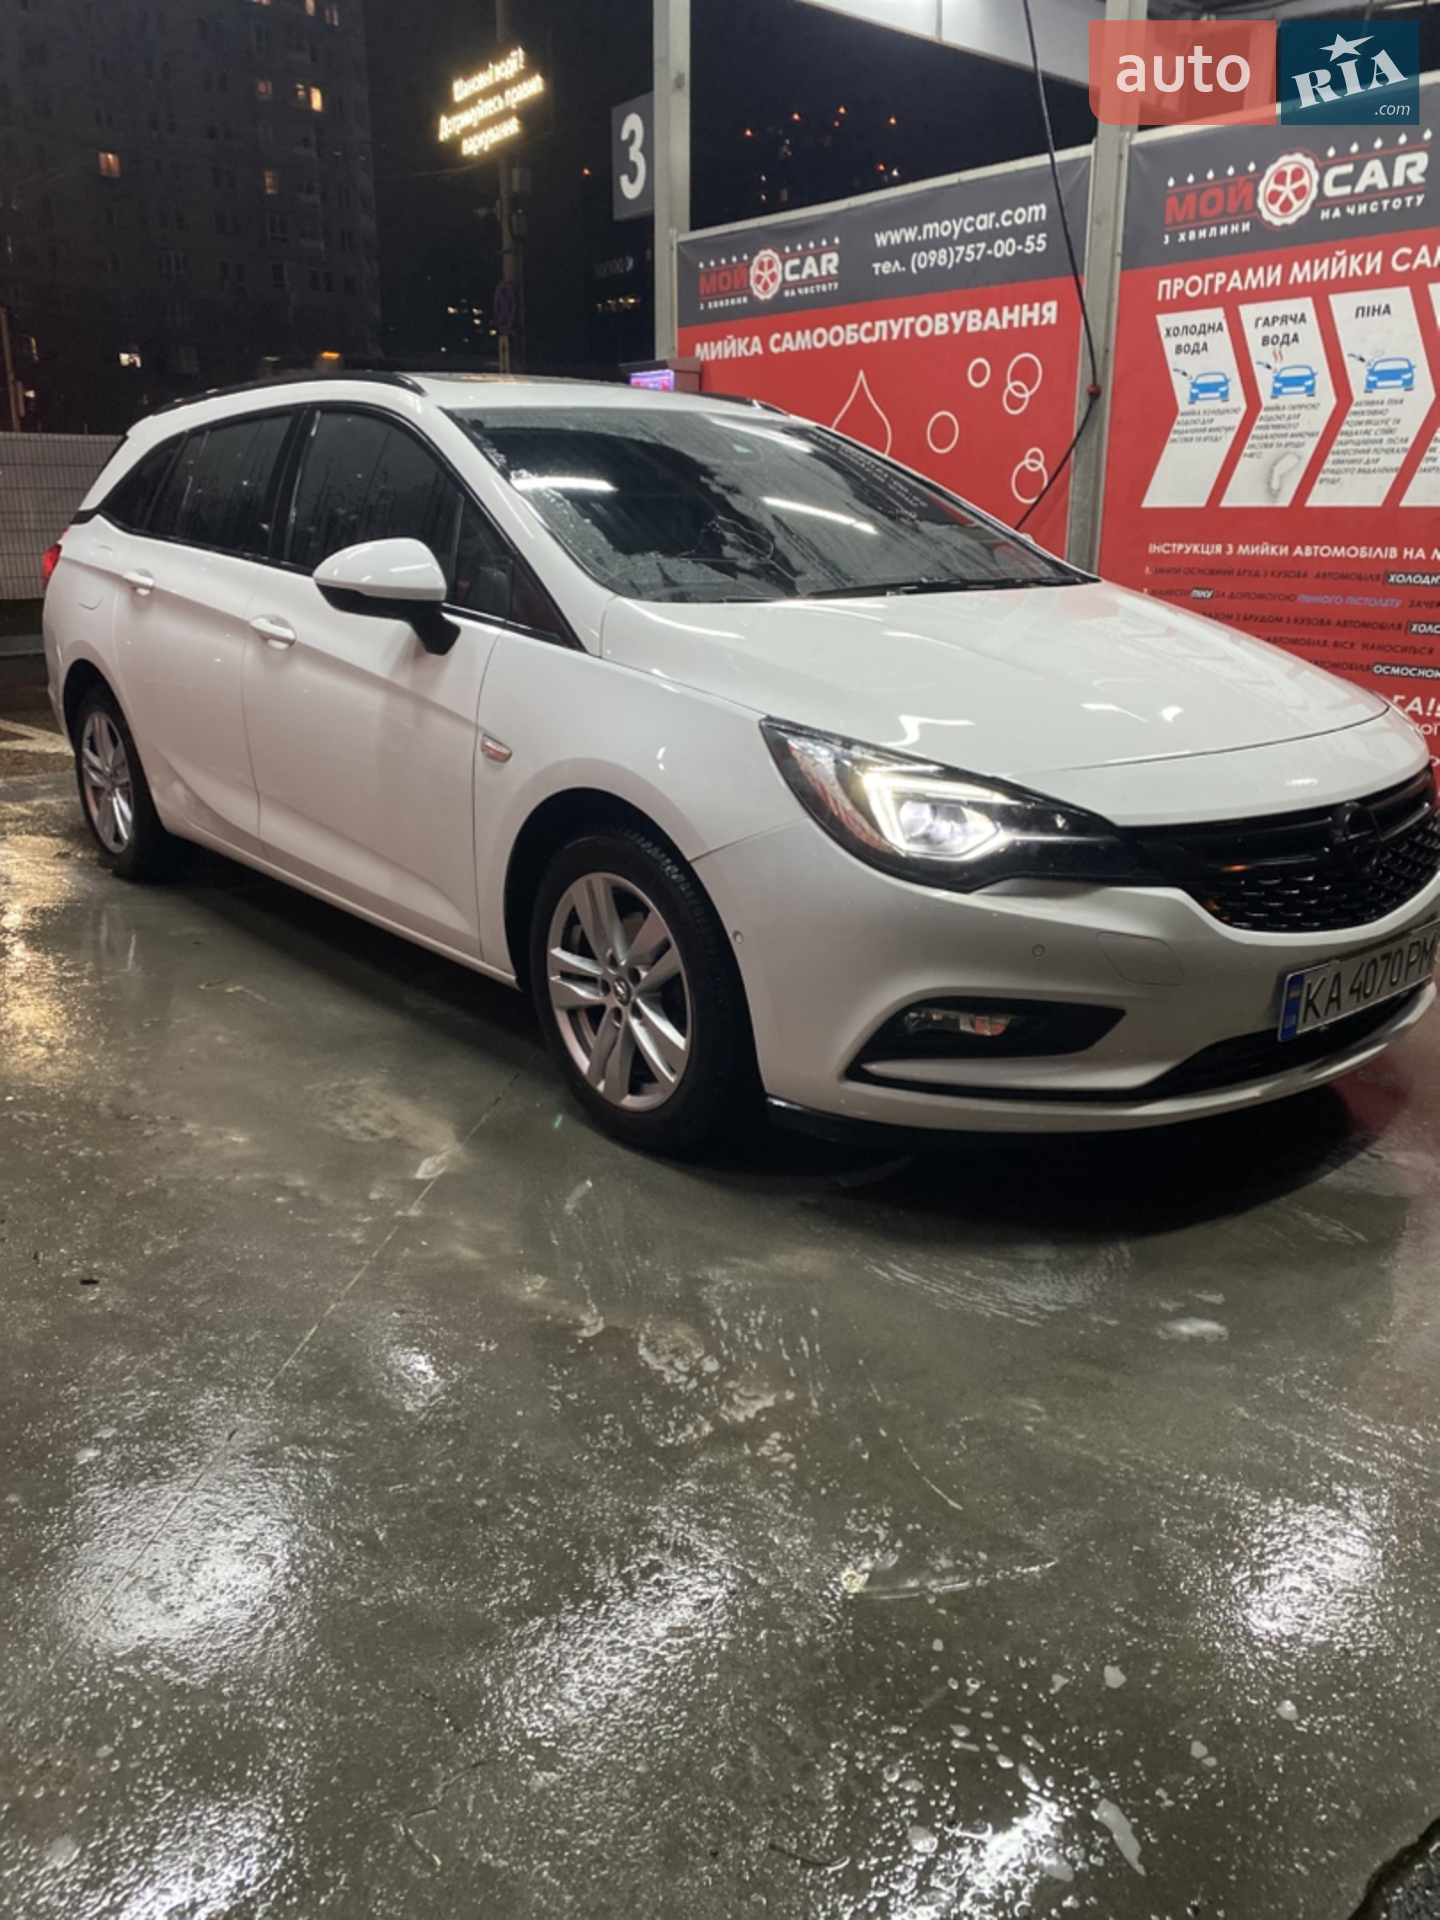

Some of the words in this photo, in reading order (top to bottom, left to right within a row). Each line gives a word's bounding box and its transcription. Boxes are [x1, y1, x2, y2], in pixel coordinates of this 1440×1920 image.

[620, 112, 647, 200] 3
[1165, 176, 1256, 226] МОЙ
[1323, 150, 1430, 198] CAR
[874, 202, 1048, 248] www.moycar.com
[1178, 221, 1252, 243] ХВИЛИНИ
[1320, 206, 1342, 221] НА
[1346, 193, 1426, 217] ЧИСТОТУ
[699, 262, 749, 296] МОЙ
[784, 251, 840, 282] CAR
[871, 259, 907, 277] тел.
[910, 232, 1048, 275] (098)757-00-55
[1157, 263, 1283, 302] ПРОГРАМИ
[1288, 249, 1384, 286] МИЙКИ
[695, 333, 764, 362] МИЙКА
[768, 300, 1059, 354] САМООБСЛУГОВУВАННЯ
[1164, 320, 1225, 339] ХОЛОДНА
[1254, 311, 1308, 329] ГАРЯЧА
[1354, 303, 1392, 320] ПІНА
[1175, 341, 1209, 356] ВОДА
[1261, 332, 1300, 348] ВОДА
[1148, 543, 1223, 556] ІНСТРУКЦІЯ
[1237, 541, 1289, 556] МИЙКИ
[1292, 545, 1398, 560] АВТОМОБІЛІВ
[1403, 547, 1427, 560] НА
[1302, 971, 1342, 1024] KA
[1349, 947, 1404, 1004] 4070
